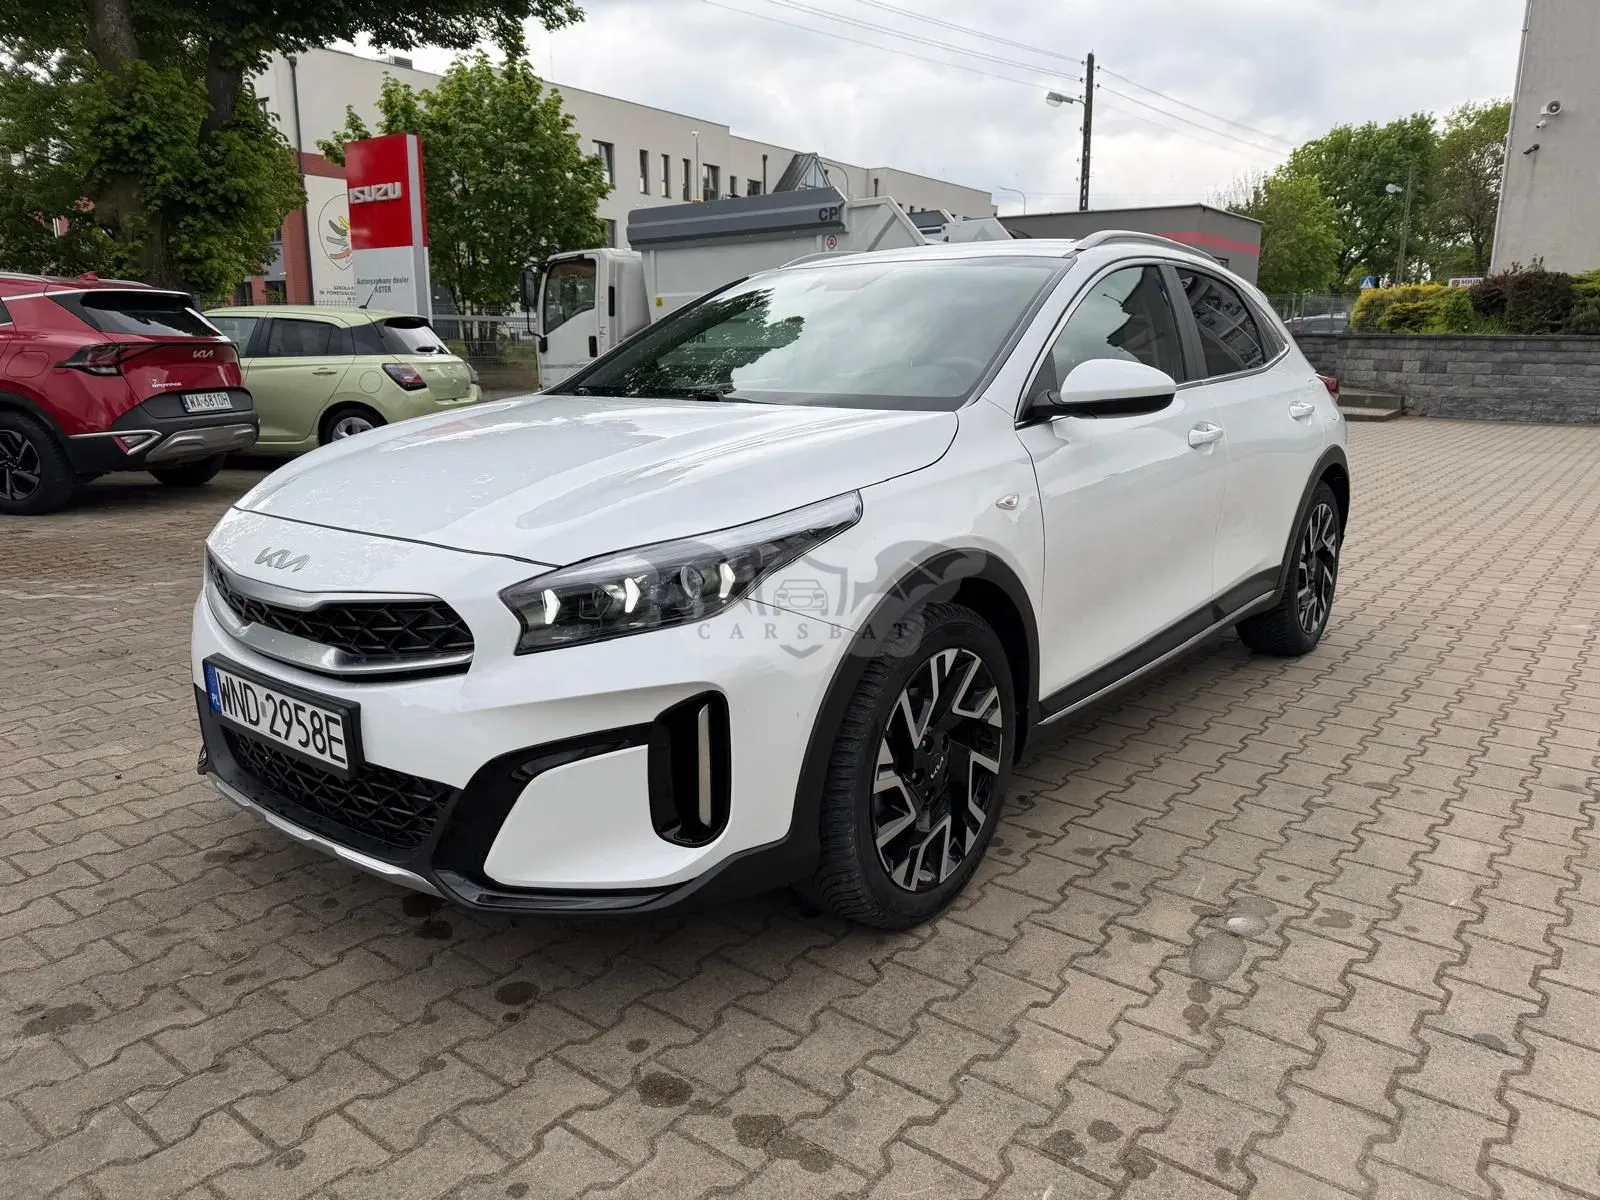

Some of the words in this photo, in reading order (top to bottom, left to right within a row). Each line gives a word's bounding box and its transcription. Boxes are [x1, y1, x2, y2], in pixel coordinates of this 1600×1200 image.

[349, 182, 402, 203] ISUZU
[192, 349, 214, 358] KIA
[254, 547, 310, 572] KIA
[216, 671, 260, 728] WND
[264, 692, 347, 764] 2958E
